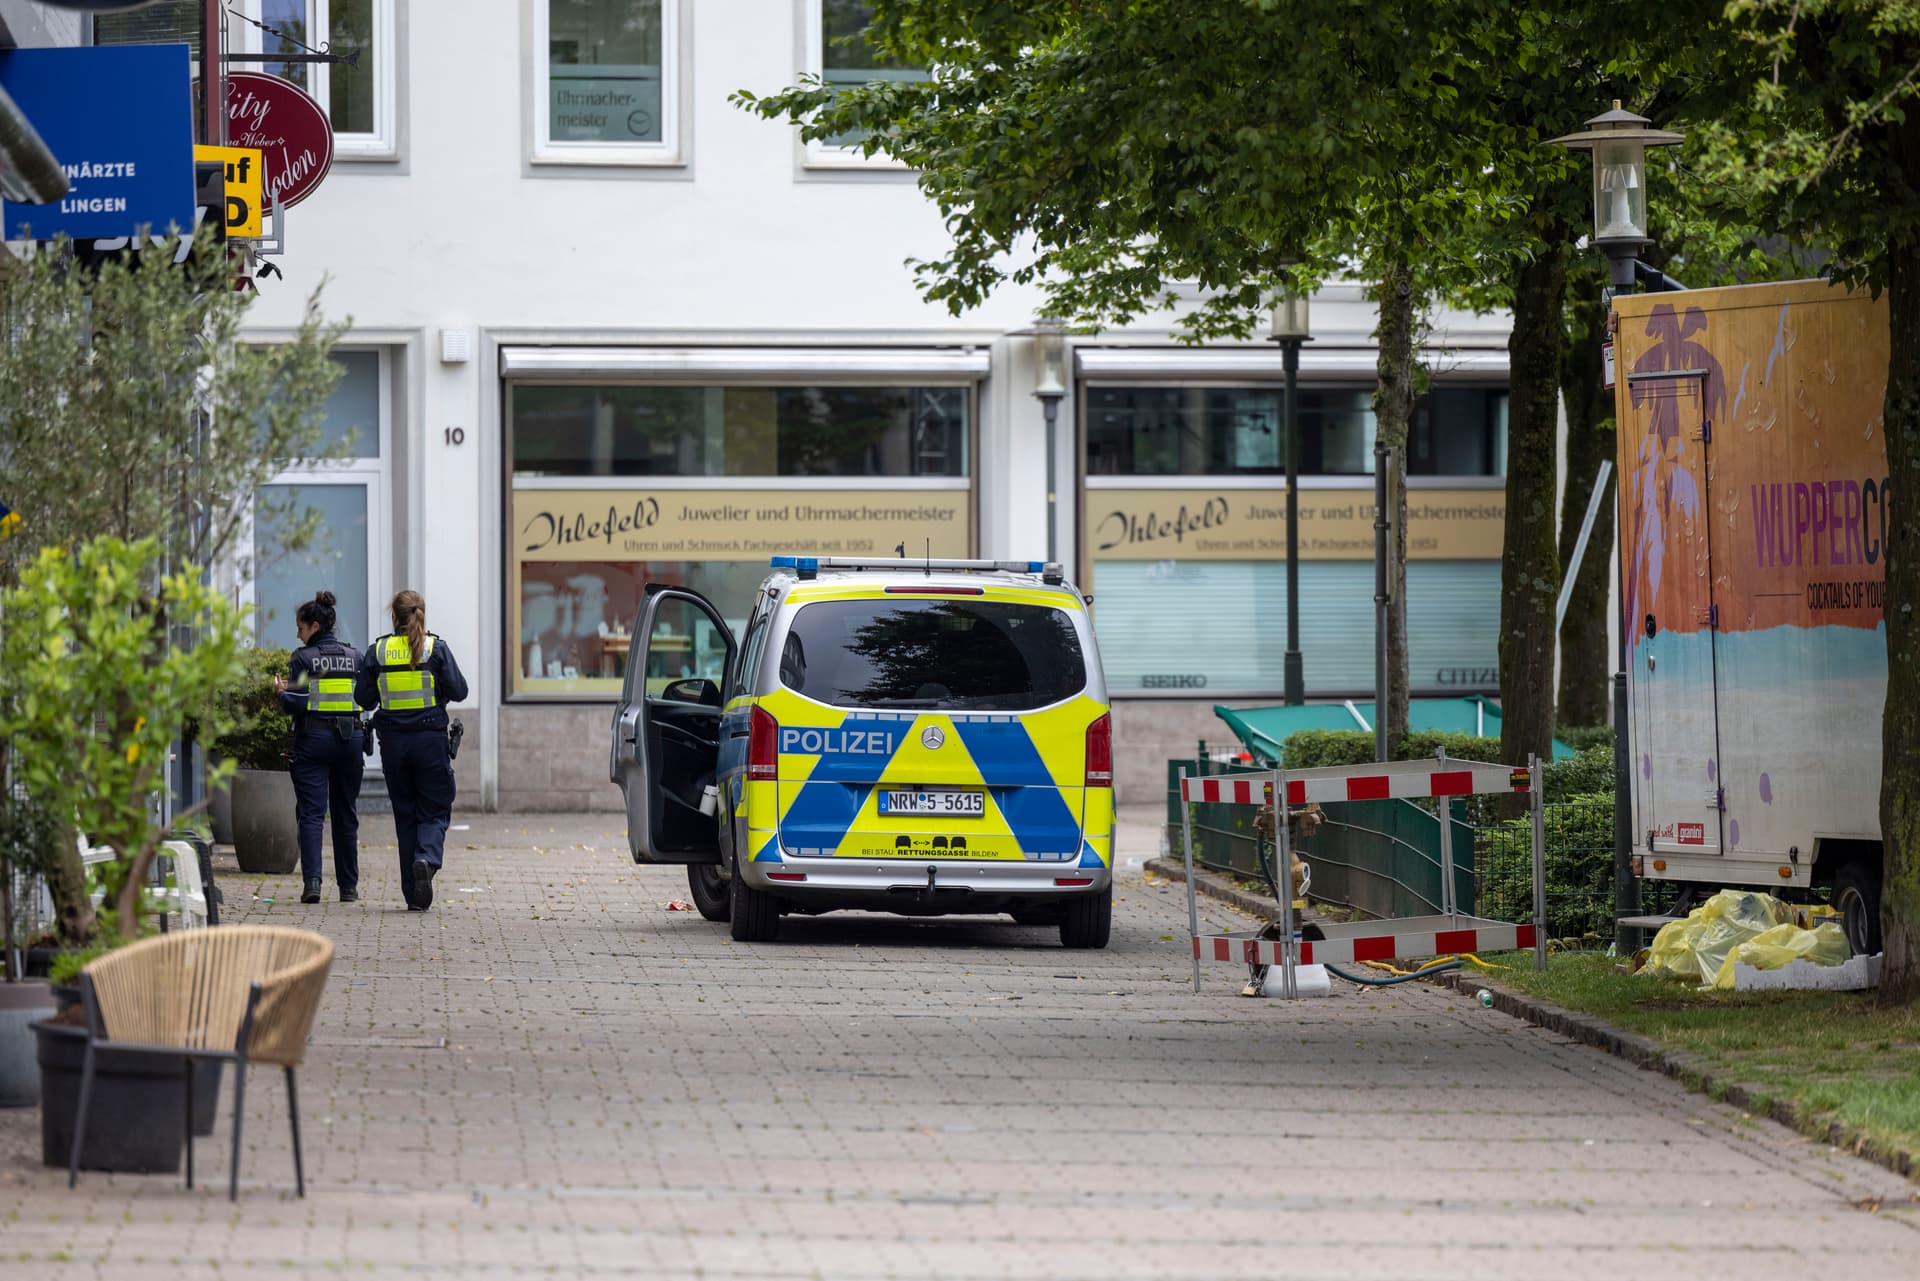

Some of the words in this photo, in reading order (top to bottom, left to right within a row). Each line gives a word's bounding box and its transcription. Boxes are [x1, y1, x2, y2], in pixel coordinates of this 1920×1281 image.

[229, 82, 272, 132] ity
[557, 112, 608, 127] meister
[61, 197, 127, 214] LINGEN
[445, 427, 465, 446] 10
[523, 497, 659, 552] Ihlefeld
[678, 505, 751, 522] Juwelier
[756, 505, 789, 521] und
[795, 505, 955, 522] Uhrmachermeister
[1096, 497, 1229, 551] Ihlefeld
[1245, 505, 1316, 521] Juweer
[1321, 505, 1354, 521] und
[624, 540, 658, 551] Uhren
[662, 540, 684, 551] und
[688, 540, 741, 552] Schmuck
[1807, 582, 1851, 609] COCKTAILS
[1853, 583, 1863, 608] OF
[386, 649, 411, 660] POLIZ
[312, 657, 355, 671] POLIZEI
[1142, 674, 1208, 688] SEIKO
[1437, 667, 1500, 685] CITIZE
[783, 729, 893, 754] POLIZEI
[889, 793, 918, 810] NRW
[897, 849, 969, 857] RETTUNGSGASSE
